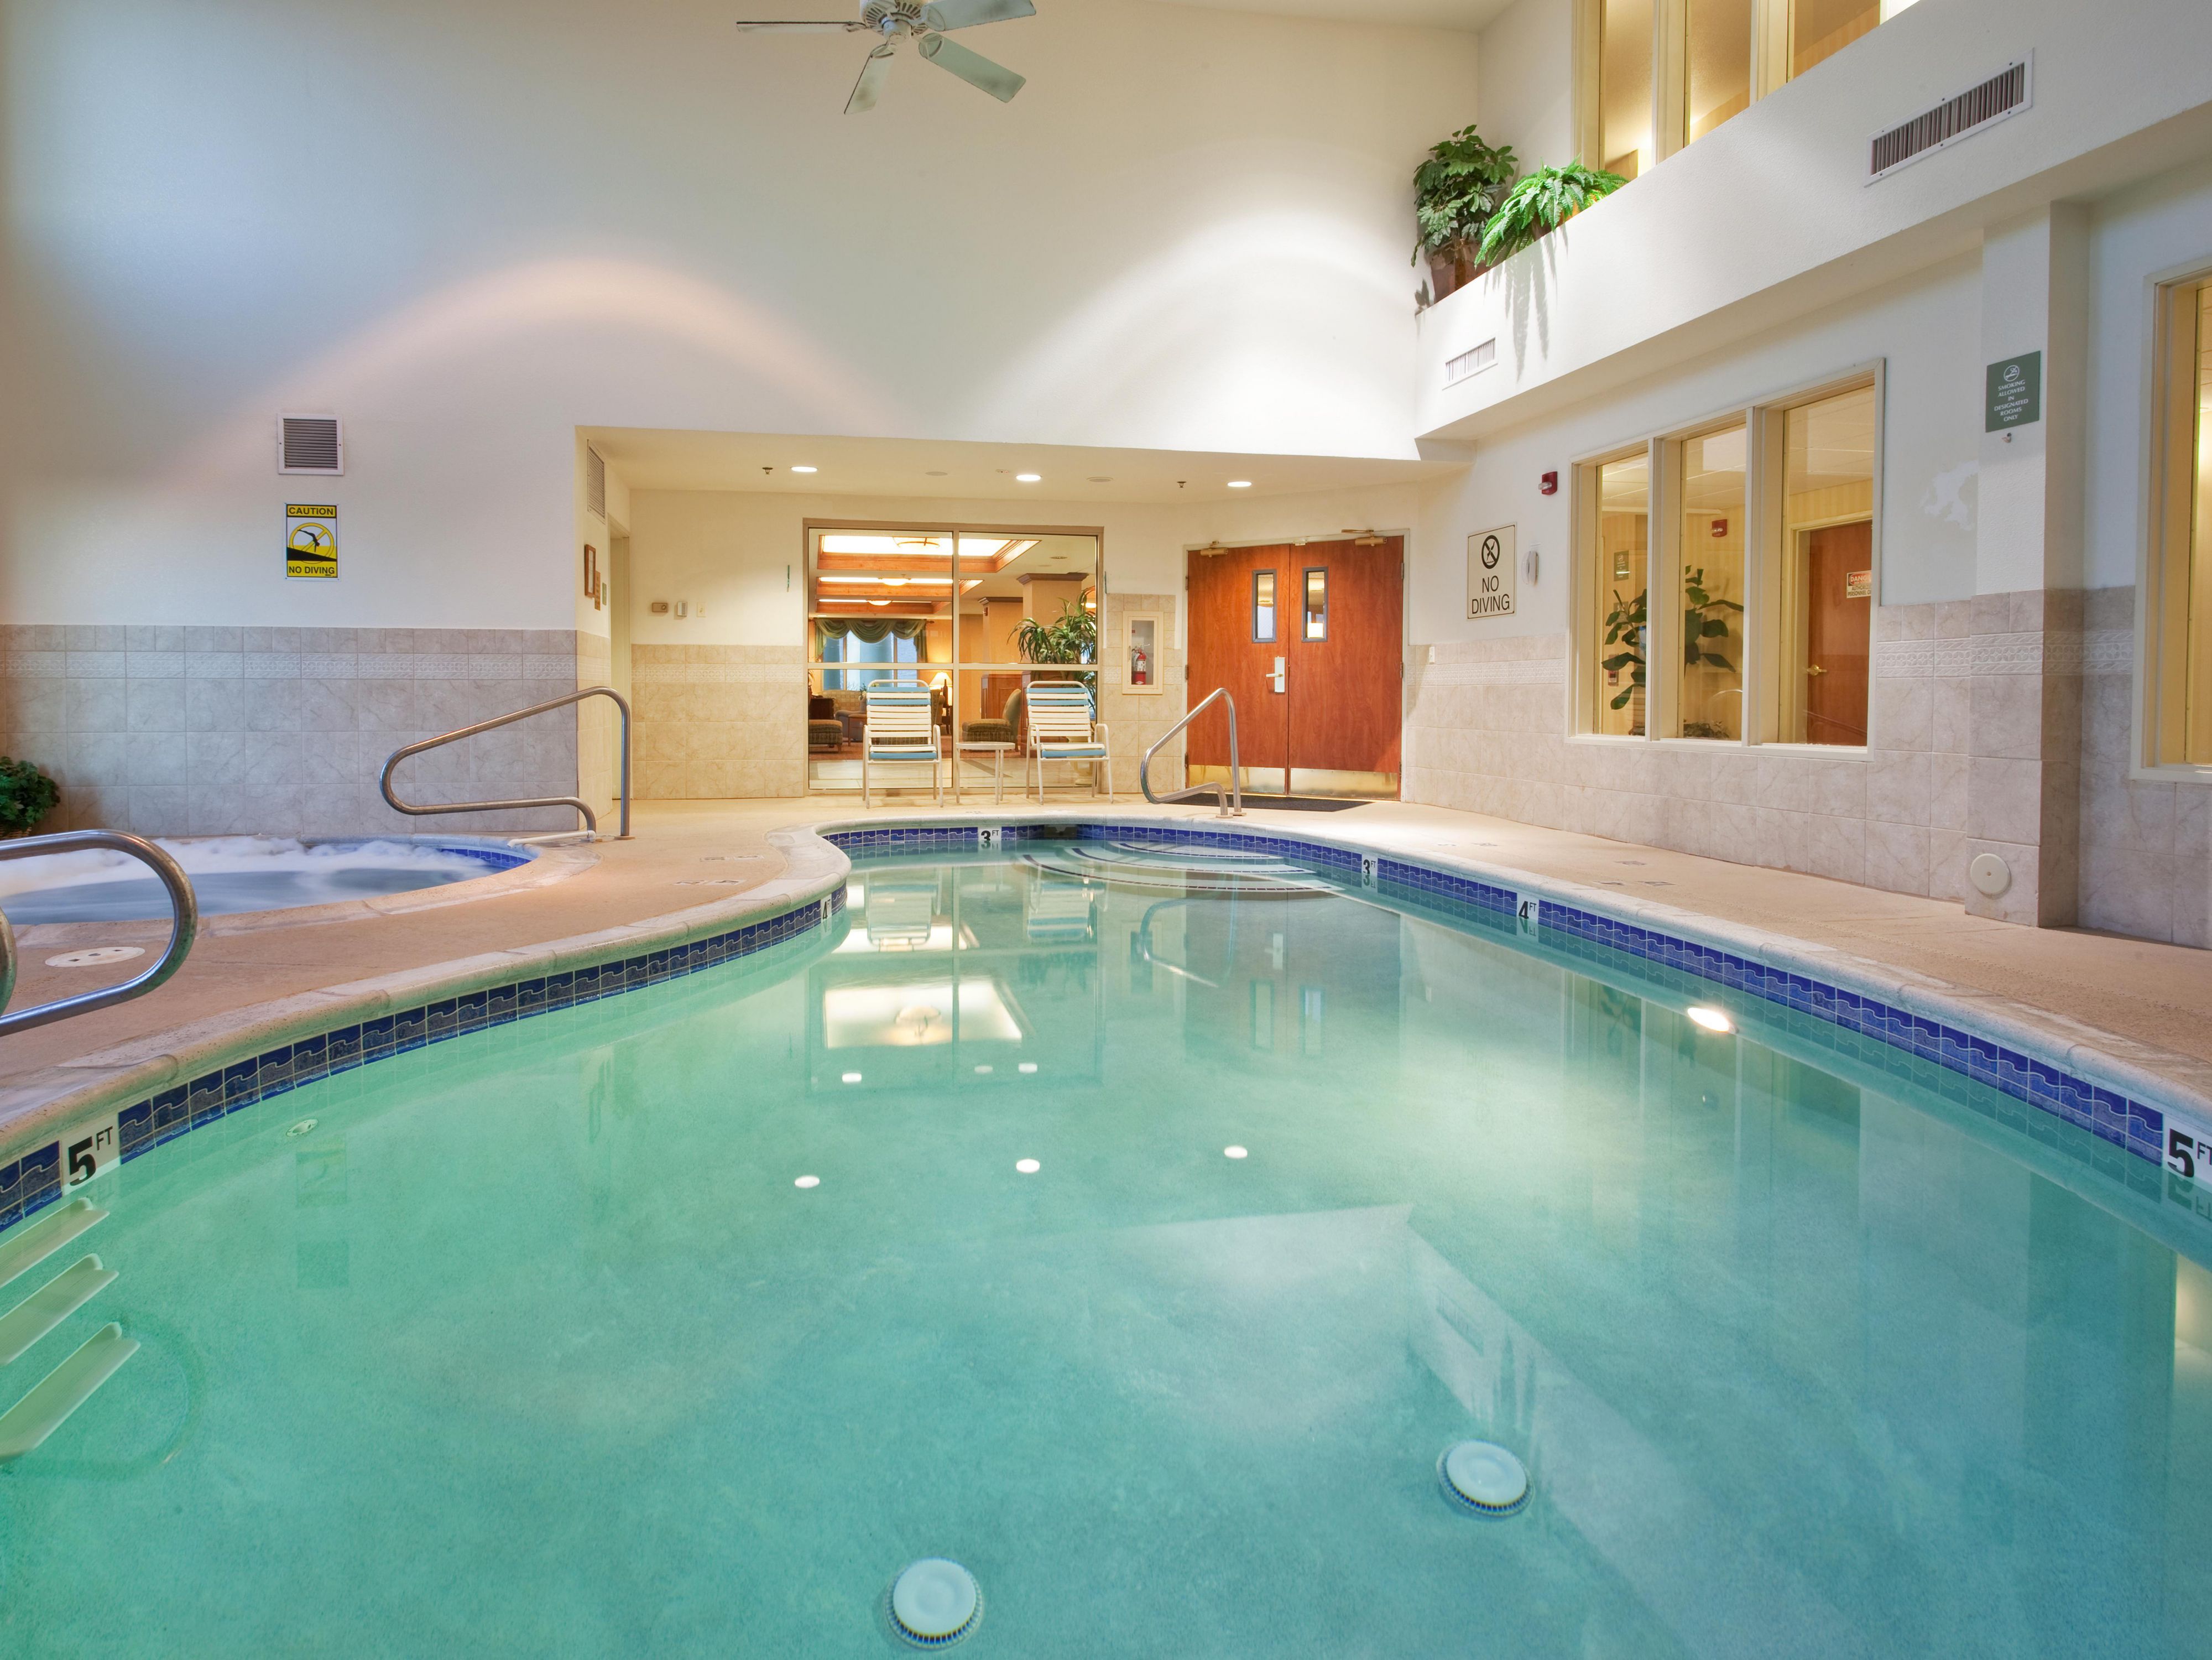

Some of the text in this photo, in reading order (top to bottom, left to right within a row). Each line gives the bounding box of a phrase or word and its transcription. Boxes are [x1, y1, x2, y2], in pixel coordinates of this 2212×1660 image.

[1998, 379, 2026, 391] SMOKING
[1998, 386, 2025, 397] ALLOWED
[1994, 398, 2028, 411] DESIGNATED
[2000, 407, 2022, 416] ROOMS
[289, 507, 333, 515] CAUTION
[1482, 575, 1499, 593] NO
[1472, 594, 1510, 614] DIVING
[981, 830, 991, 841] 3
[1363, 859, 1370, 874] 3
[823, 901, 827, 919] 4
[1519, 901, 1537, 919] 4 FT
[69, 1126, 113, 1186] 5 FT
[2167, 1128, 2212, 1178] 5 FT
